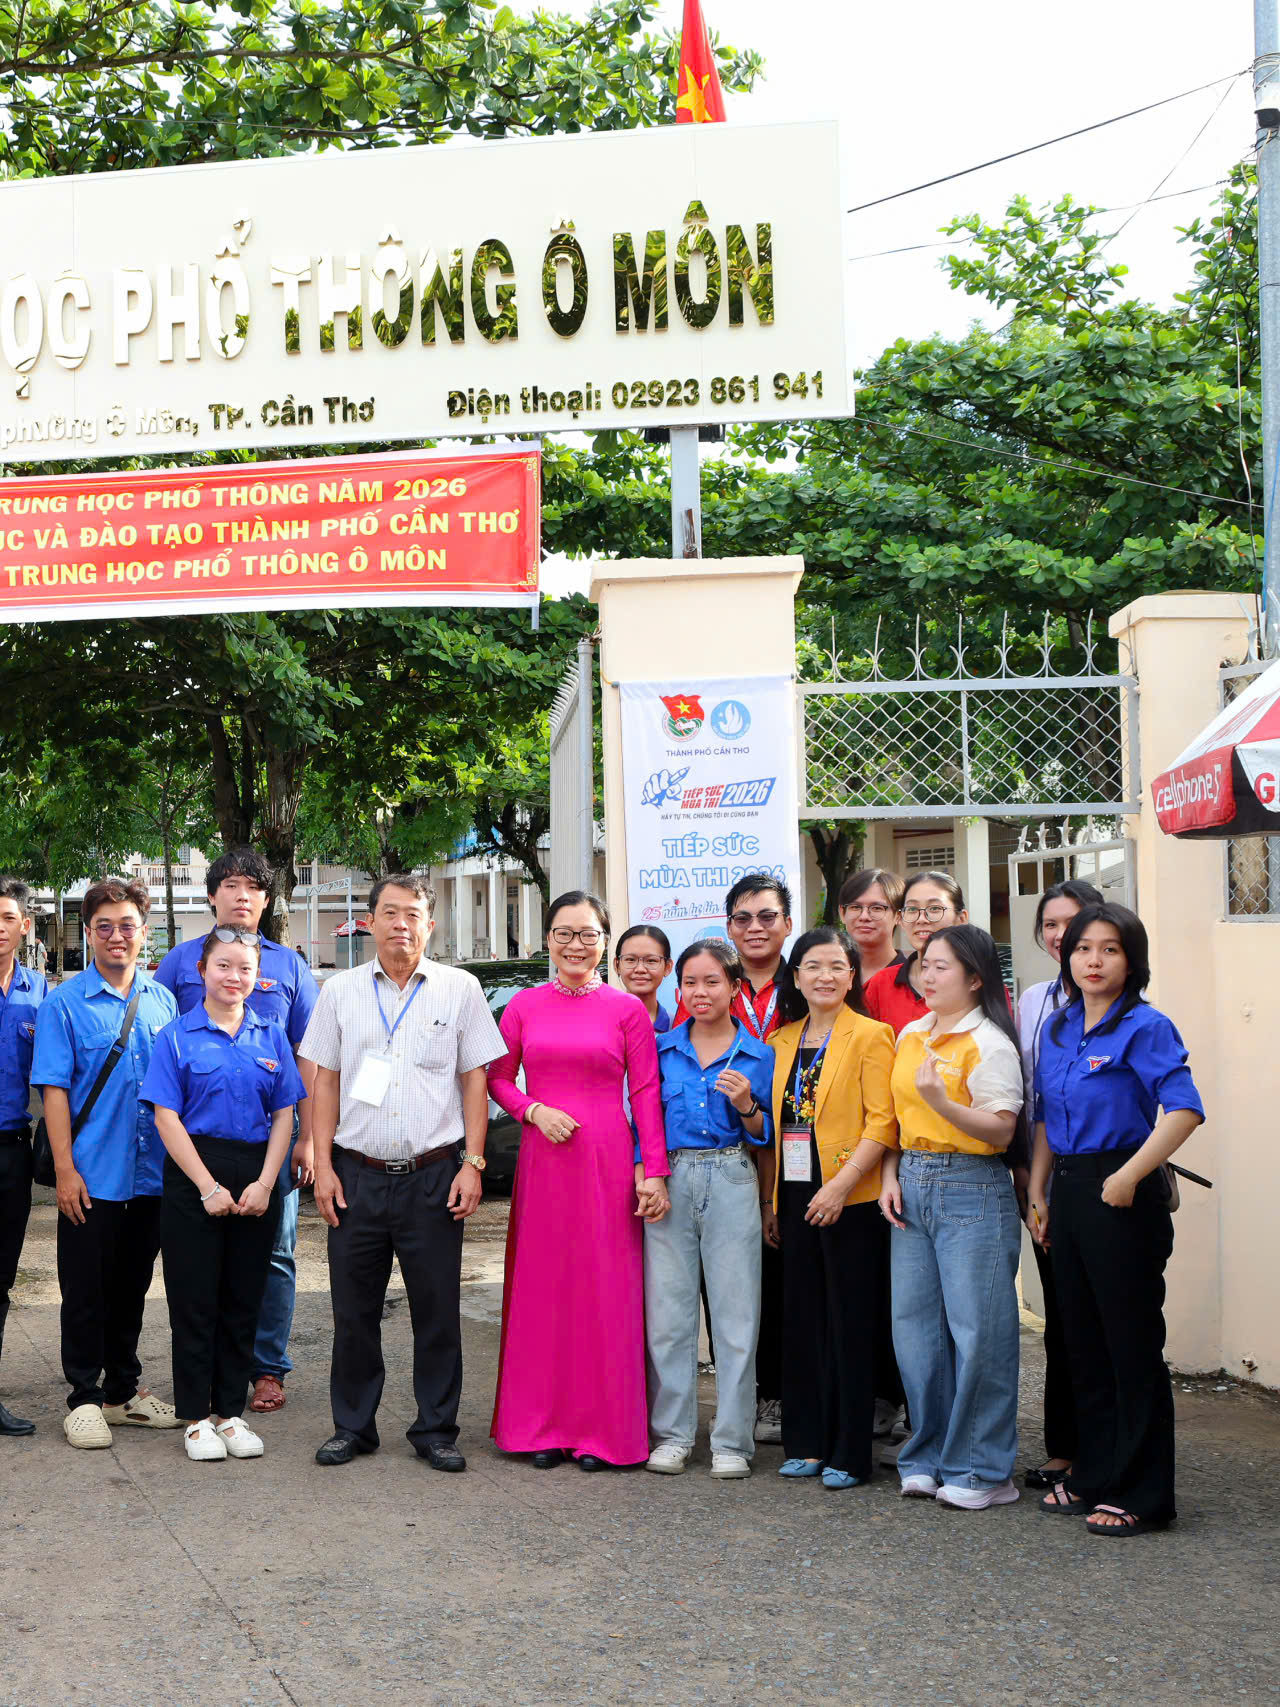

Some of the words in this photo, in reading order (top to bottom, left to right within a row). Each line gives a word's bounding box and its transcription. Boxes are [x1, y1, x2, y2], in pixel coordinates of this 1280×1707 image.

[113, 207, 253, 365] PHỔ
[270, 223, 519, 353] THÔNG
[541, 211, 589, 339] Ô
[612, 200, 774, 335] MÔN
[446, 387, 511, 424] Điện
[520, 382, 602, 419] thoại:
[611, 378, 700, 411] 02923
[710, 374, 760, 404] 861
[773, 370, 824, 401] 941
[0, 415, 97, 448] phường
[106, 405, 128, 437] Ô
[134, 406, 199, 437] Môn,
[208, 401, 252, 430] TP.
[260, 394, 314, 427] Cần
[323, 395, 376, 423] Thơ
[76, 492, 134, 514] HỌC
[144, 482, 205, 510] PHỔ
[214, 482, 309, 508] THÔNG
[319, 478, 383, 504] NĂM
[393, 478, 467, 501] 2026
[33, 525, 68, 549] VÀ
[80, 520, 137, 548] ĐÀO
[147, 522, 203, 549] TẠO
[212, 515, 310, 544] THÀNH
[321, 508, 382, 538] PHỐ
[390, 504, 449, 535] CẦN
[458, 508, 520, 535] THƠ
[4, 563, 97, 588] TRUNG
[107, 560, 164, 584] HỌC
[173, 547, 232, 579] PHỔ
[241, 547, 339, 576] THÔNG
[348, 545, 369, 573] Ô
[380, 544, 447, 572] MÔN
[723, 780, 770, 806] 2026
[662, 832, 709, 858] TIẾP
[712, 832, 760, 856] SỨC
[640, 865, 690, 889] MÙA
[693, 867, 728, 888] THI
[641, 906, 662, 921] 25
